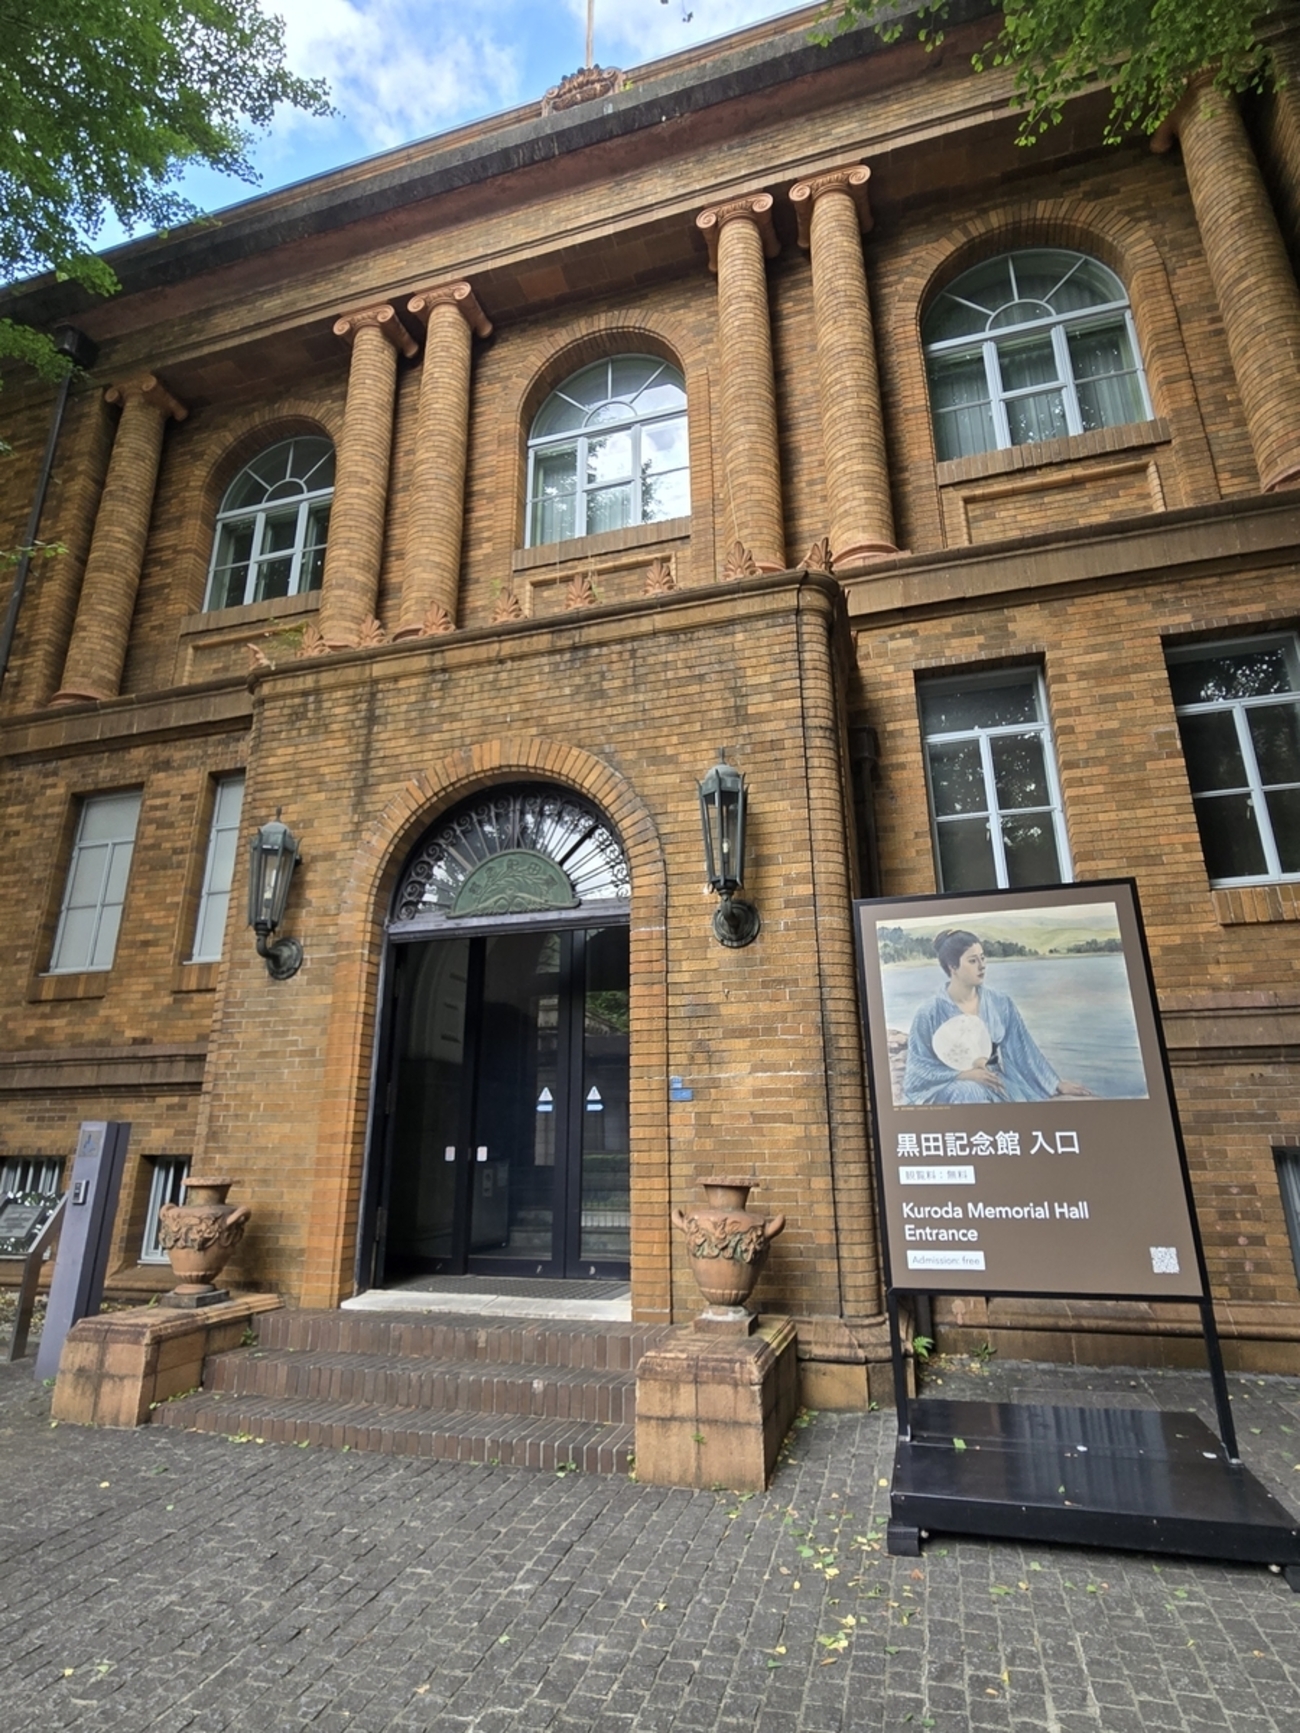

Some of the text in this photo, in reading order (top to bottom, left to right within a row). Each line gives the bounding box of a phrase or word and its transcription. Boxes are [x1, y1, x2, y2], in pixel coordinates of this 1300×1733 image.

[896, 1129, 1080, 1157] 黒田記念館 入口
[902, 1201, 1090, 1220] Kuroda Memorial Hall
[904, 1224, 979, 1242] Entrance
[912, 1255, 981, 1266] Admission: free
